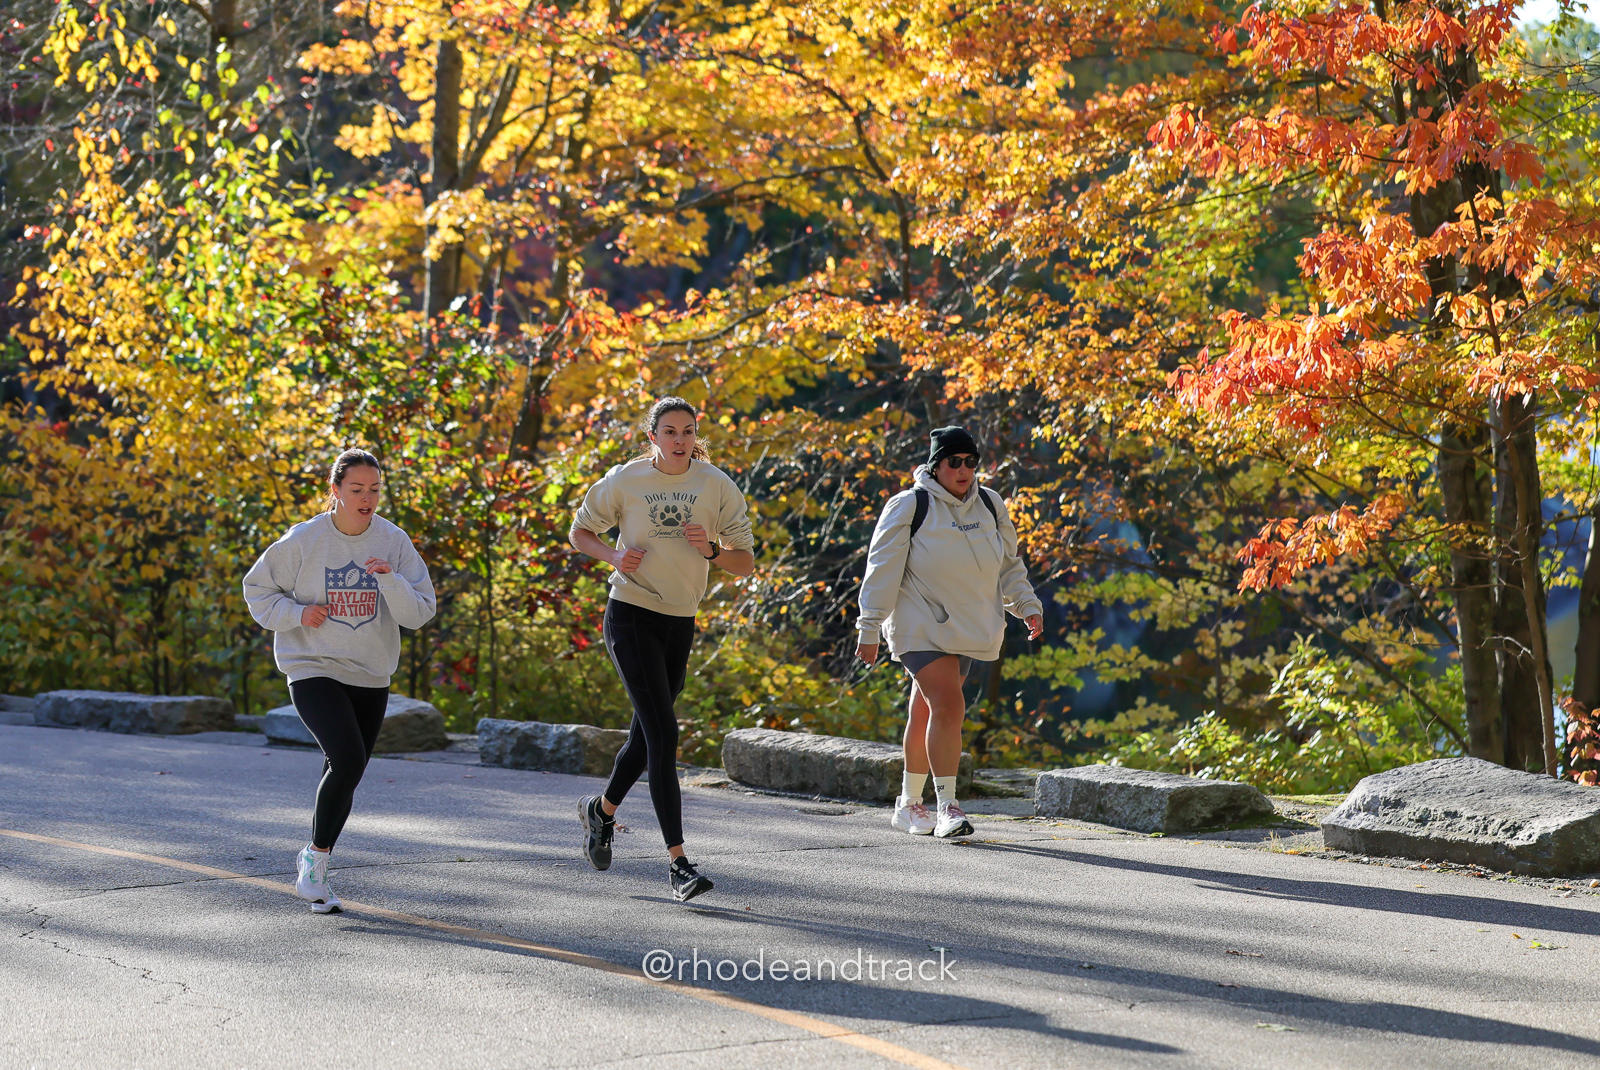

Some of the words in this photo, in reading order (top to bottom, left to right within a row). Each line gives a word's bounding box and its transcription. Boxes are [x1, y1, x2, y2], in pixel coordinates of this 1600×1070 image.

[644, 492, 667, 504] DOG
[671, 492, 698, 505] MOM
[327, 591, 377, 604] TAYLOR
[329, 603, 376, 617] NATION
